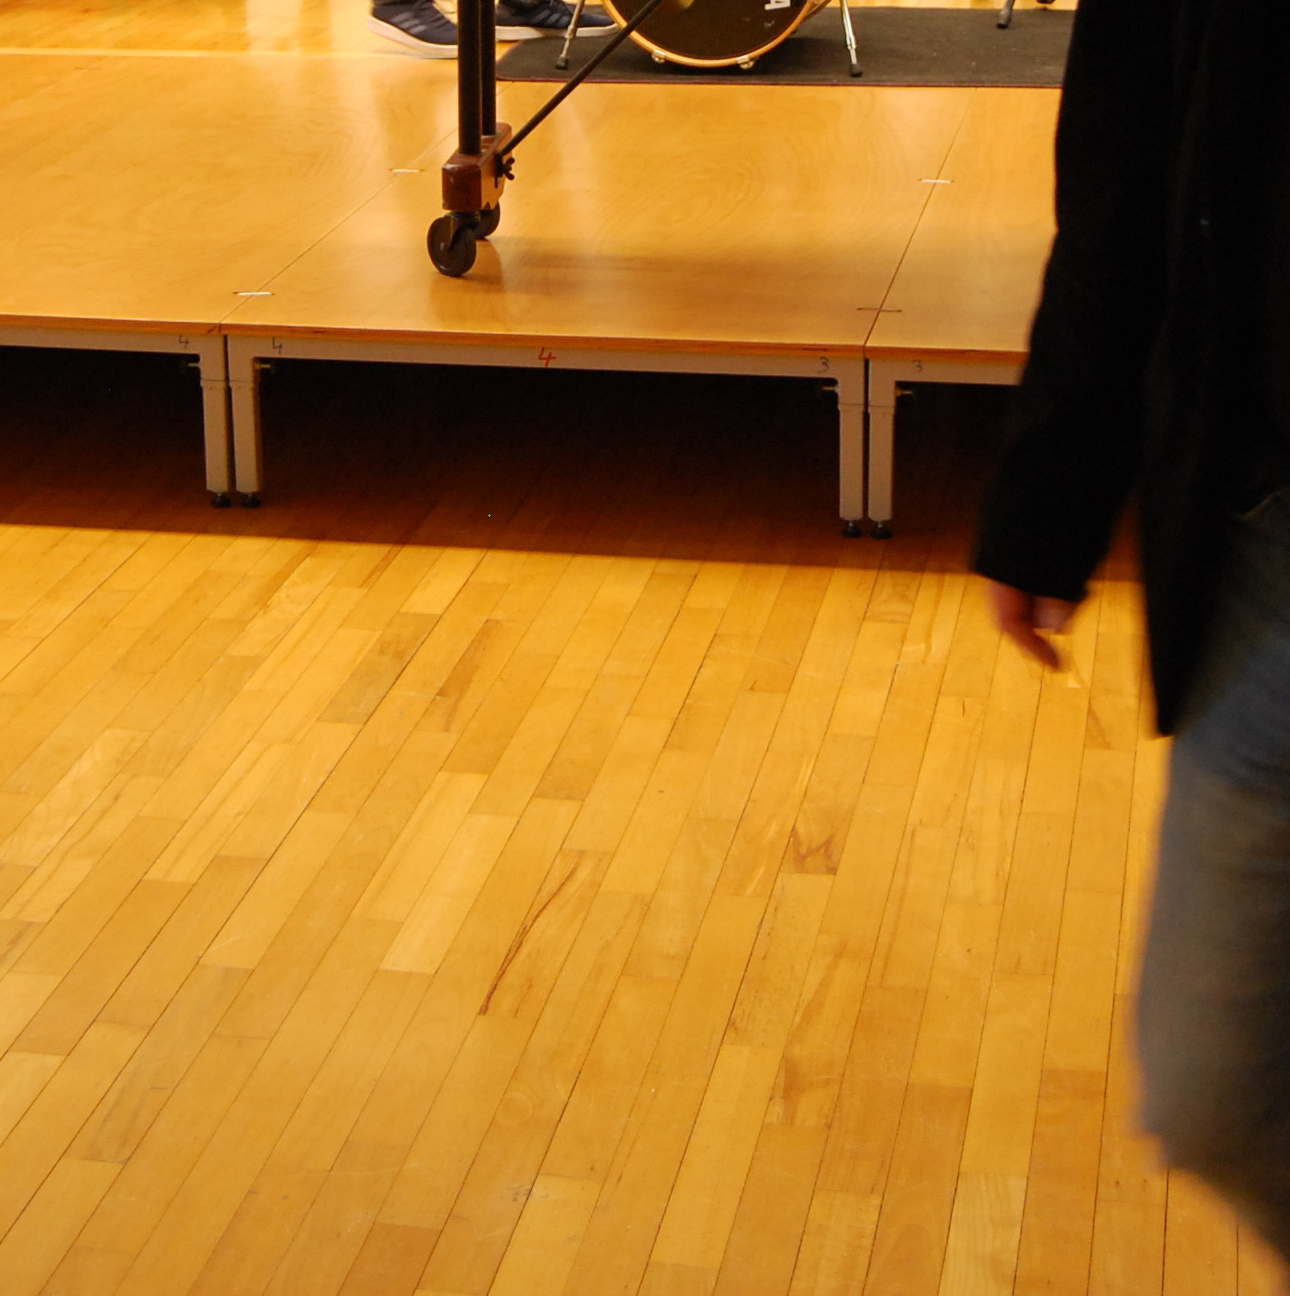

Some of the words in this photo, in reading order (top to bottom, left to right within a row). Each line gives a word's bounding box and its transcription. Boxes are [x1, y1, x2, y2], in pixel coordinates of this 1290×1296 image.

[272, 337, 283, 355] 4
[538, 346, 557, 368] 4
[817, 356, 830, 374] 3
